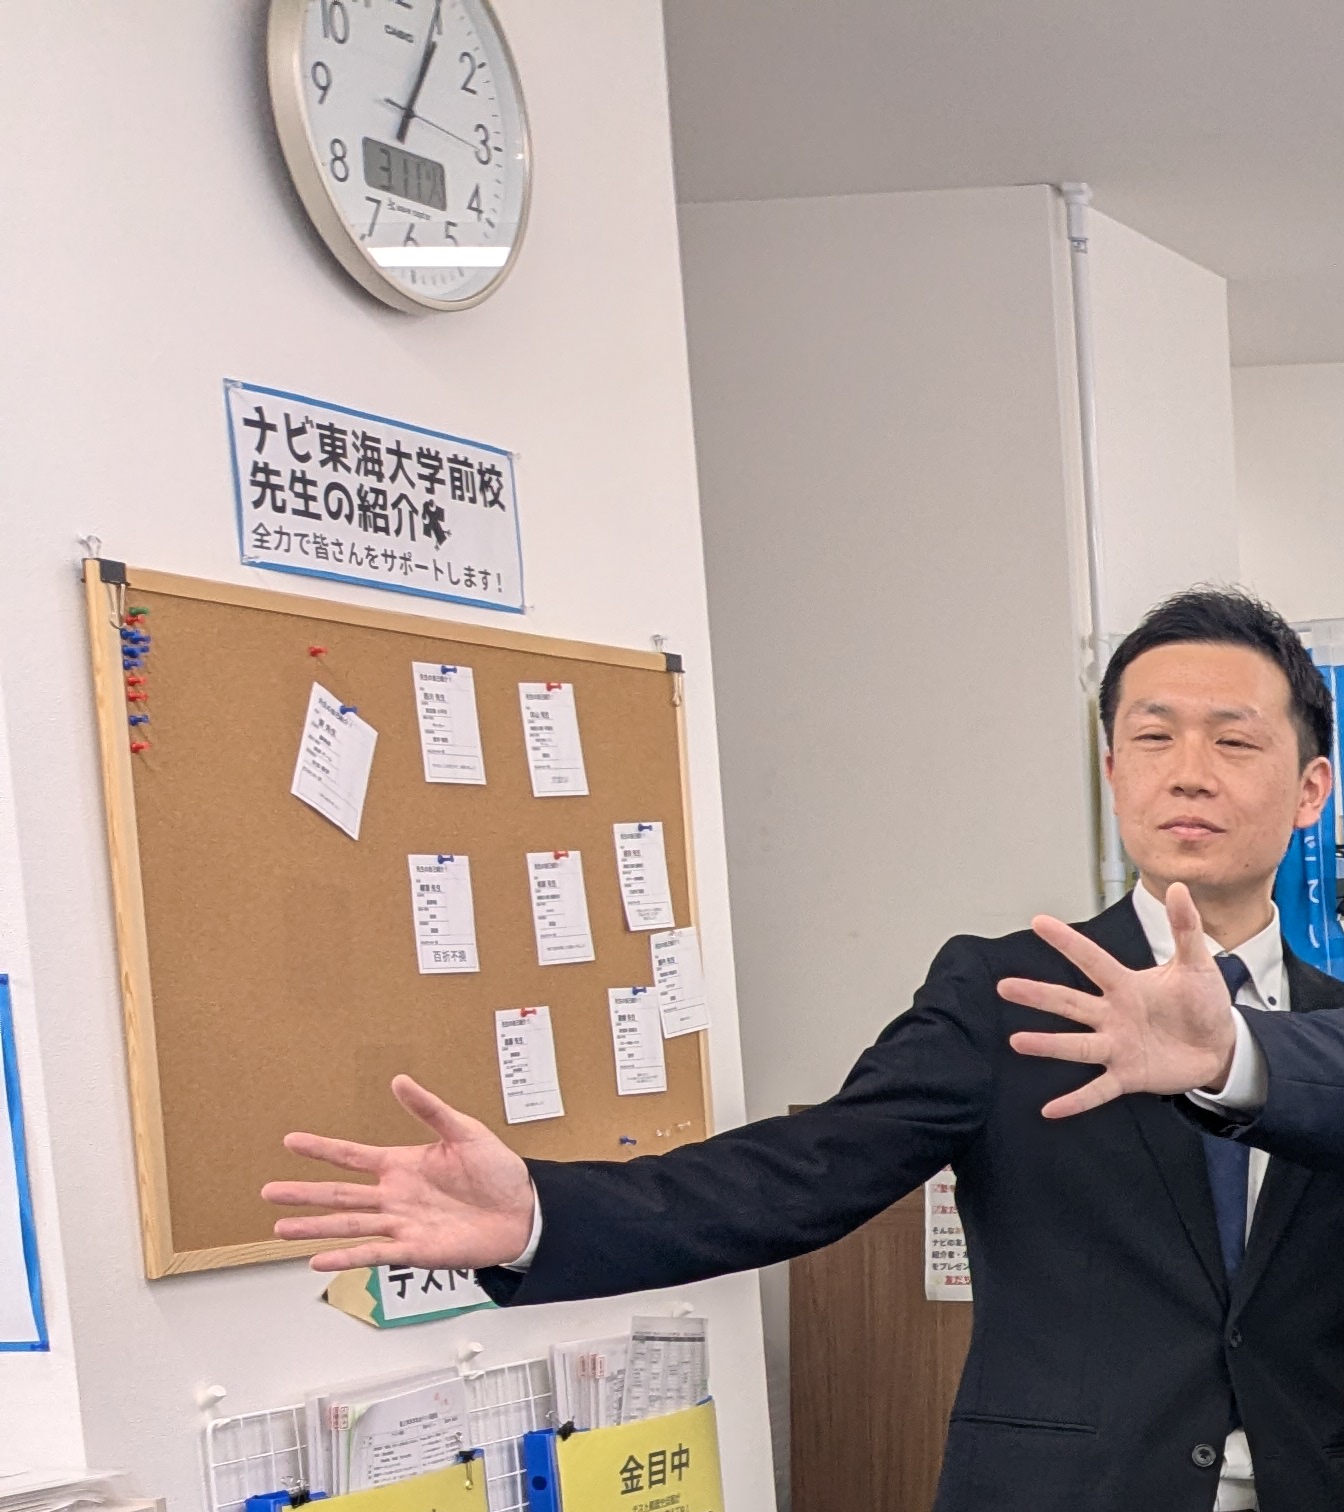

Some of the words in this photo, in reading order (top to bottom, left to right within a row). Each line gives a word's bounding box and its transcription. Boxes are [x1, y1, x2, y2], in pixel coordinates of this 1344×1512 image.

[321, 0, 349, 44] 10
[311, 61, 332, 105] 9
[459, 51, 477, 95] 2
[330, 138, 349, 182] 8
[474, 123, 492, 165] 3
[365, 196, 382, 237] 7
[467, 183, 484, 222] 4
[242, 405, 506, 513] ナビ東海大学前校
[249, 459, 419, 543] 先生の紹介
[251, 521, 504, 594] 全力で皆さんをサポートします！
[619, 1442, 690, 1496] 金目中
